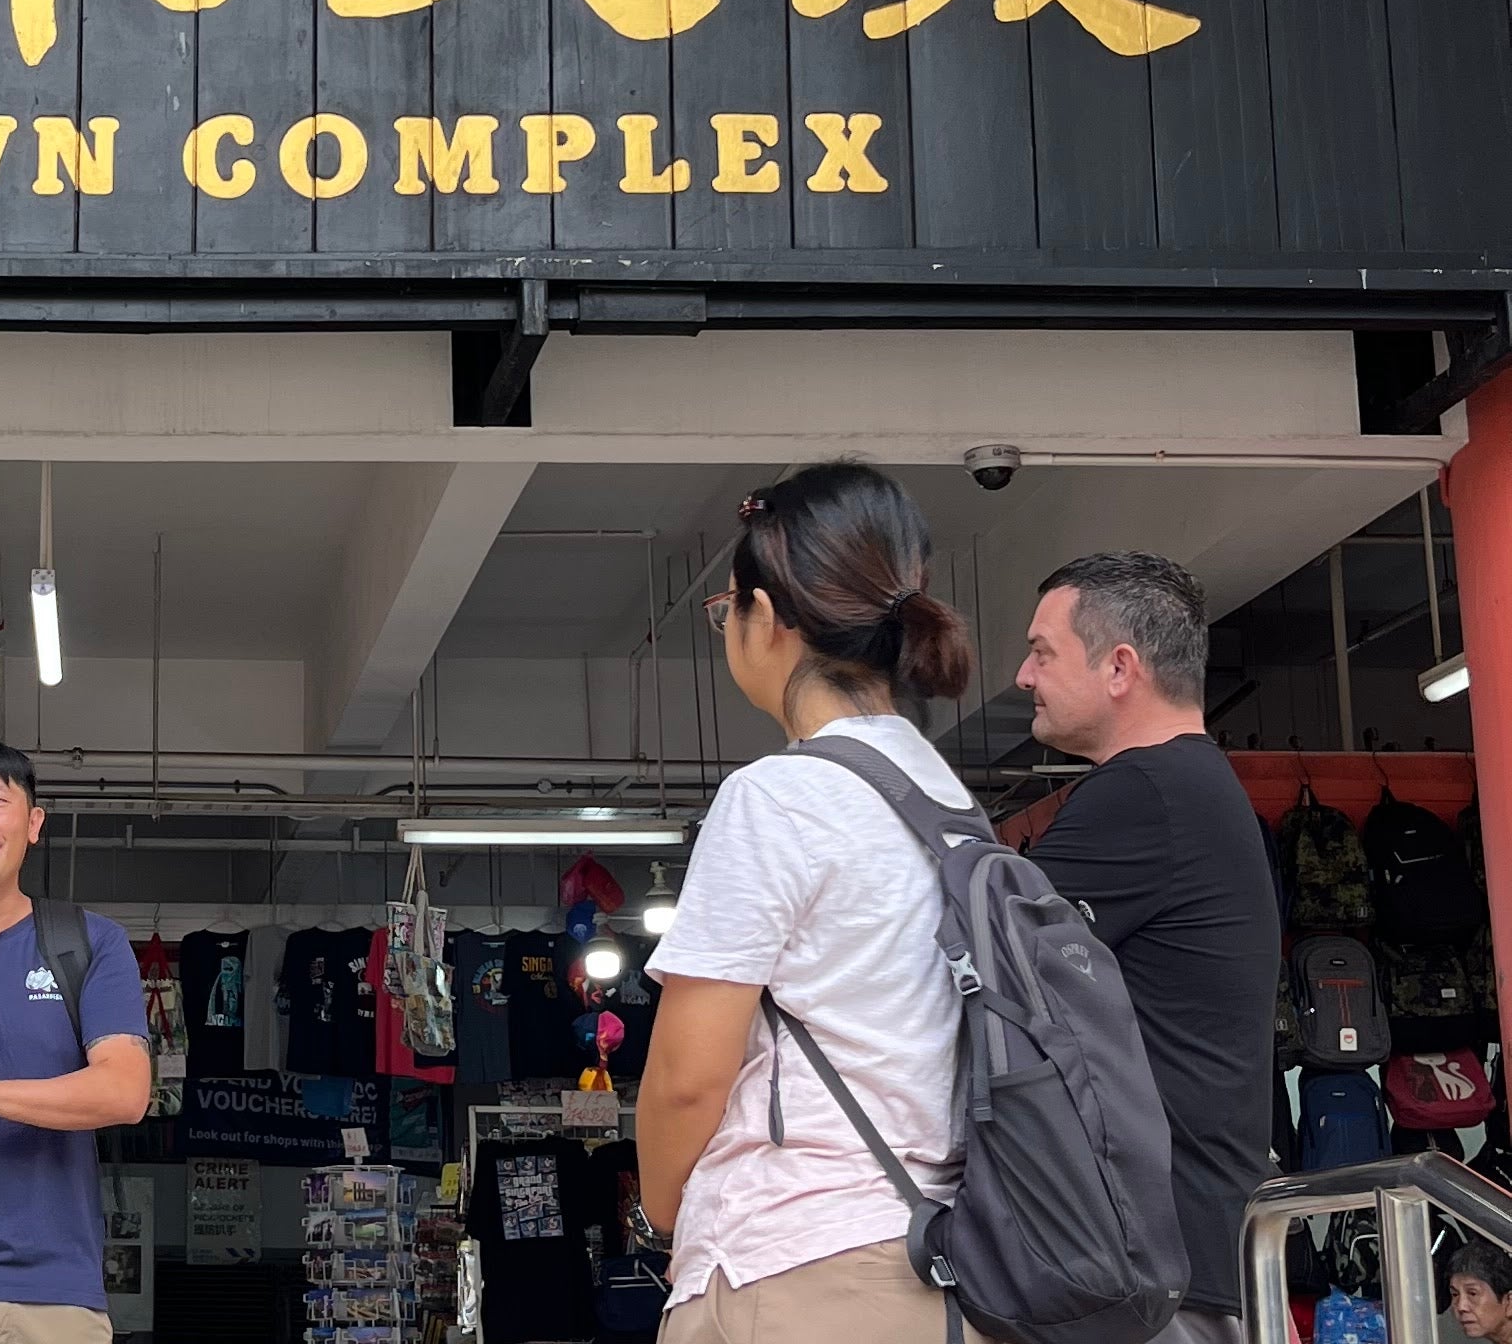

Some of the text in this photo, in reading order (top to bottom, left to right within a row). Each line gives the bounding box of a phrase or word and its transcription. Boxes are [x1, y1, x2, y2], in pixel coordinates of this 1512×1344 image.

[183, 112, 889, 199] COMPLEX
[1060, 943, 1090, 958] OSPREY
[197, 1088, 320, 1120] VOUCHER
[189, 1128, 218, 1141] Look
[220, 1131, 242, 1143] out
[244, 1131, 261, 1143] for
[263, 1133, 299, 1148] shops
[300, 1137, 325, 1149] with
[194, 1162, 249, 1175] CRIME
[194, 1177, 250, 1190] ALERT
